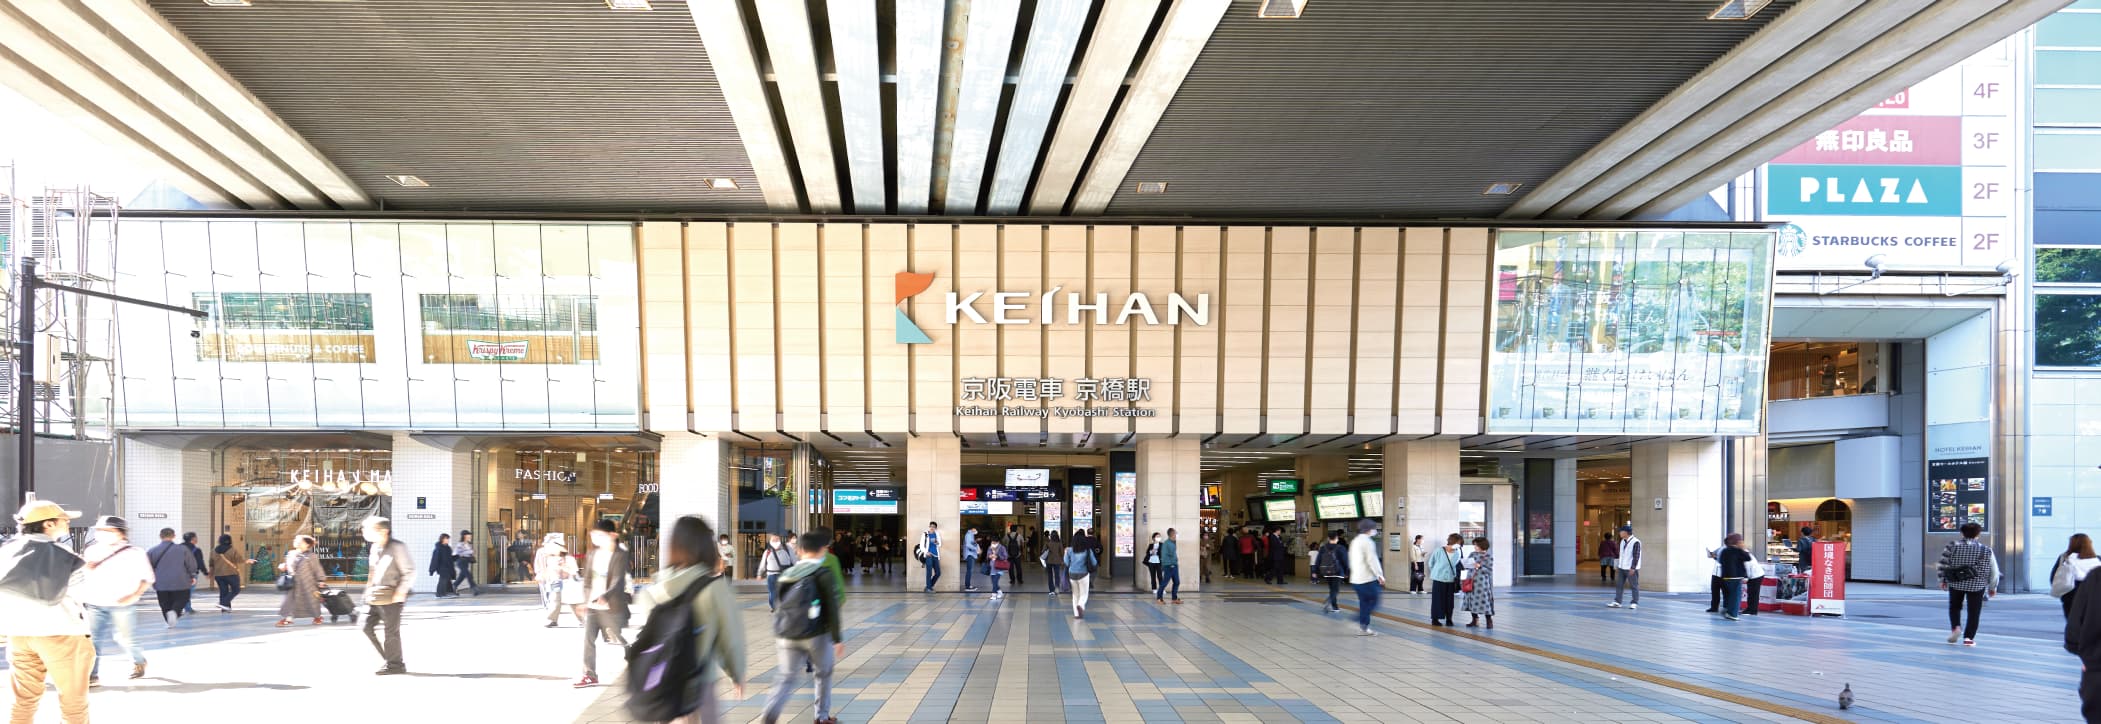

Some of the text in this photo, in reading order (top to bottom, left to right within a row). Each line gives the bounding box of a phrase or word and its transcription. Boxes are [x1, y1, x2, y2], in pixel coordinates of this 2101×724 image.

[1973, 83, 1999, 99] 4F
[1815, 129, 1913, 153] 無印良品
[1973, 132, 1999, 149] 3F
[1800, 177, 1928, 203] PLAZA
[1973, 183, 1999, 200] 2F
[1812, 235, 1957, 247] STARBUCKS COFFEE
[1973, 233, 1999, 250] 2F
[945, 286, 1209, 327] KEIHAN
[961, 377, 1151, 401] 京阪電車 京橋駅
[955, 406, 1155, 419] Keihan Railway Kyobashi Station
